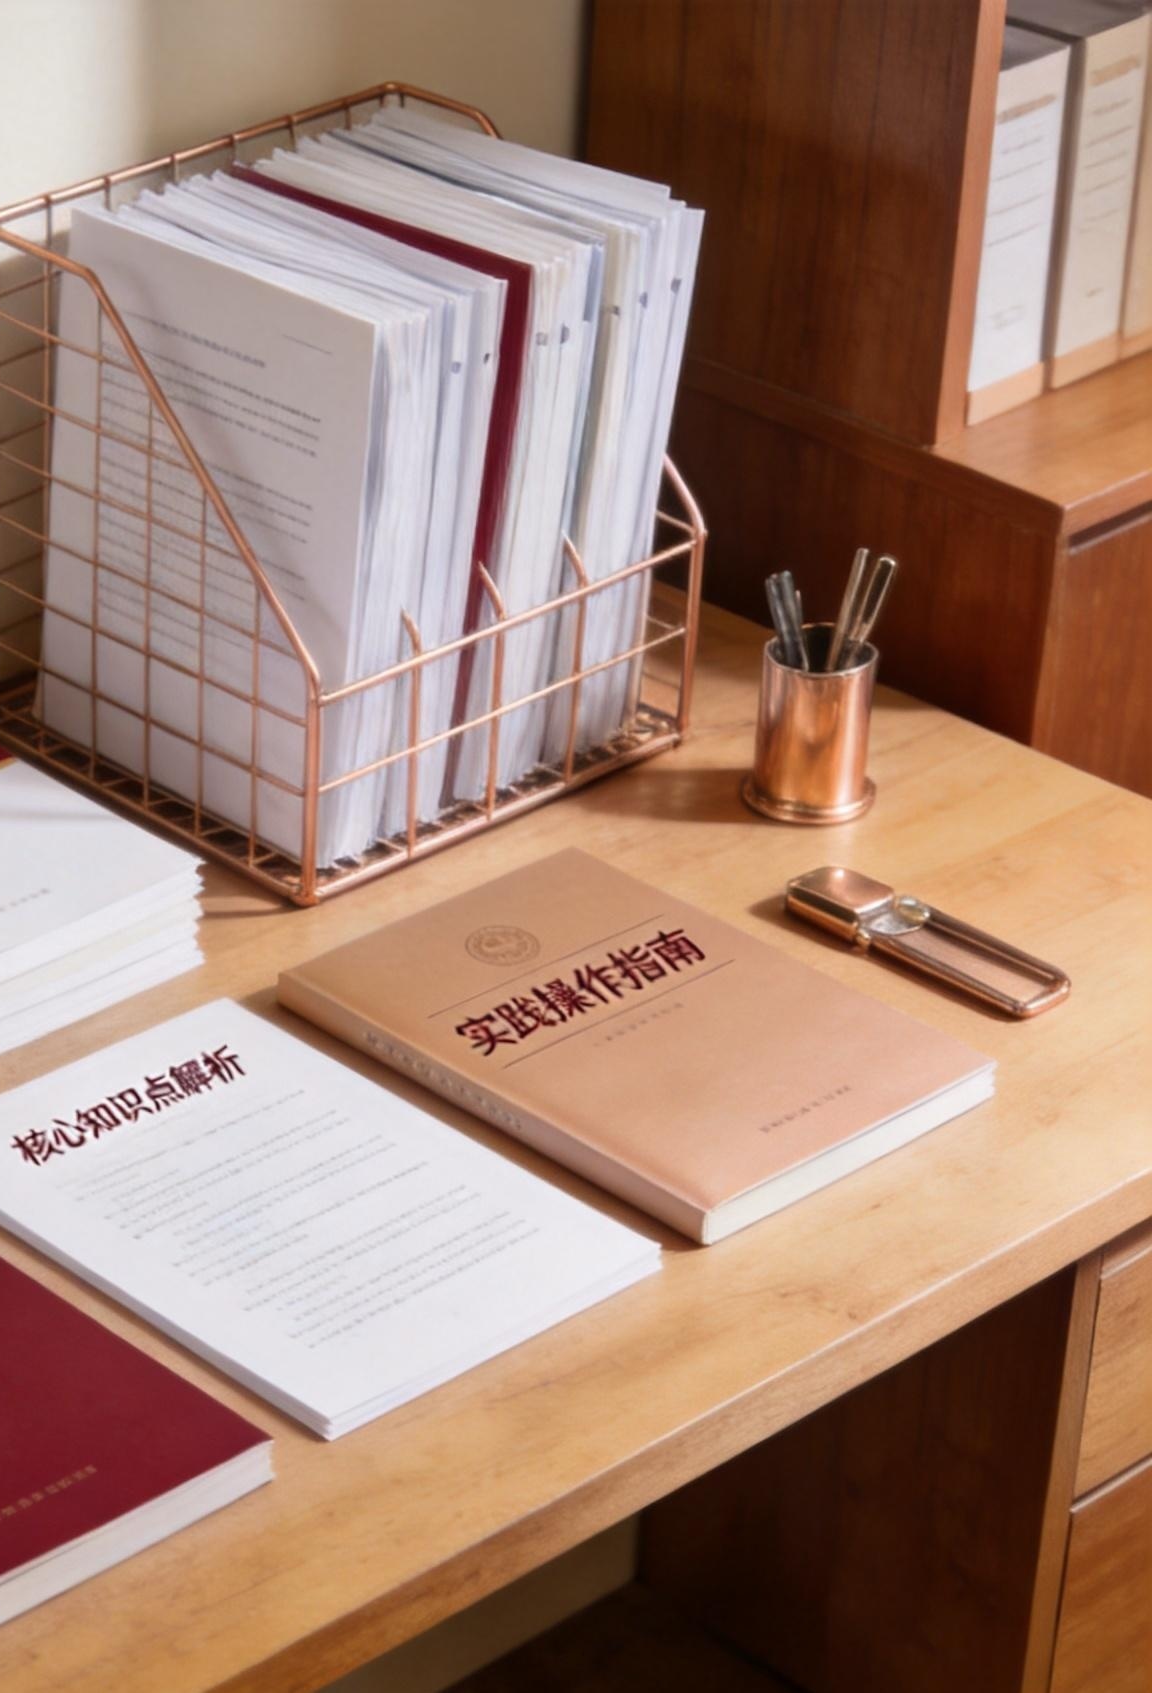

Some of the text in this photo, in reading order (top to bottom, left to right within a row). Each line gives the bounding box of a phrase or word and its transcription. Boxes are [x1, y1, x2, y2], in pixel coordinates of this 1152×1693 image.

[455, 929, 706, 1056] 实践操作指南
[11, 1044, 246, 1166] 核心知识点解析
